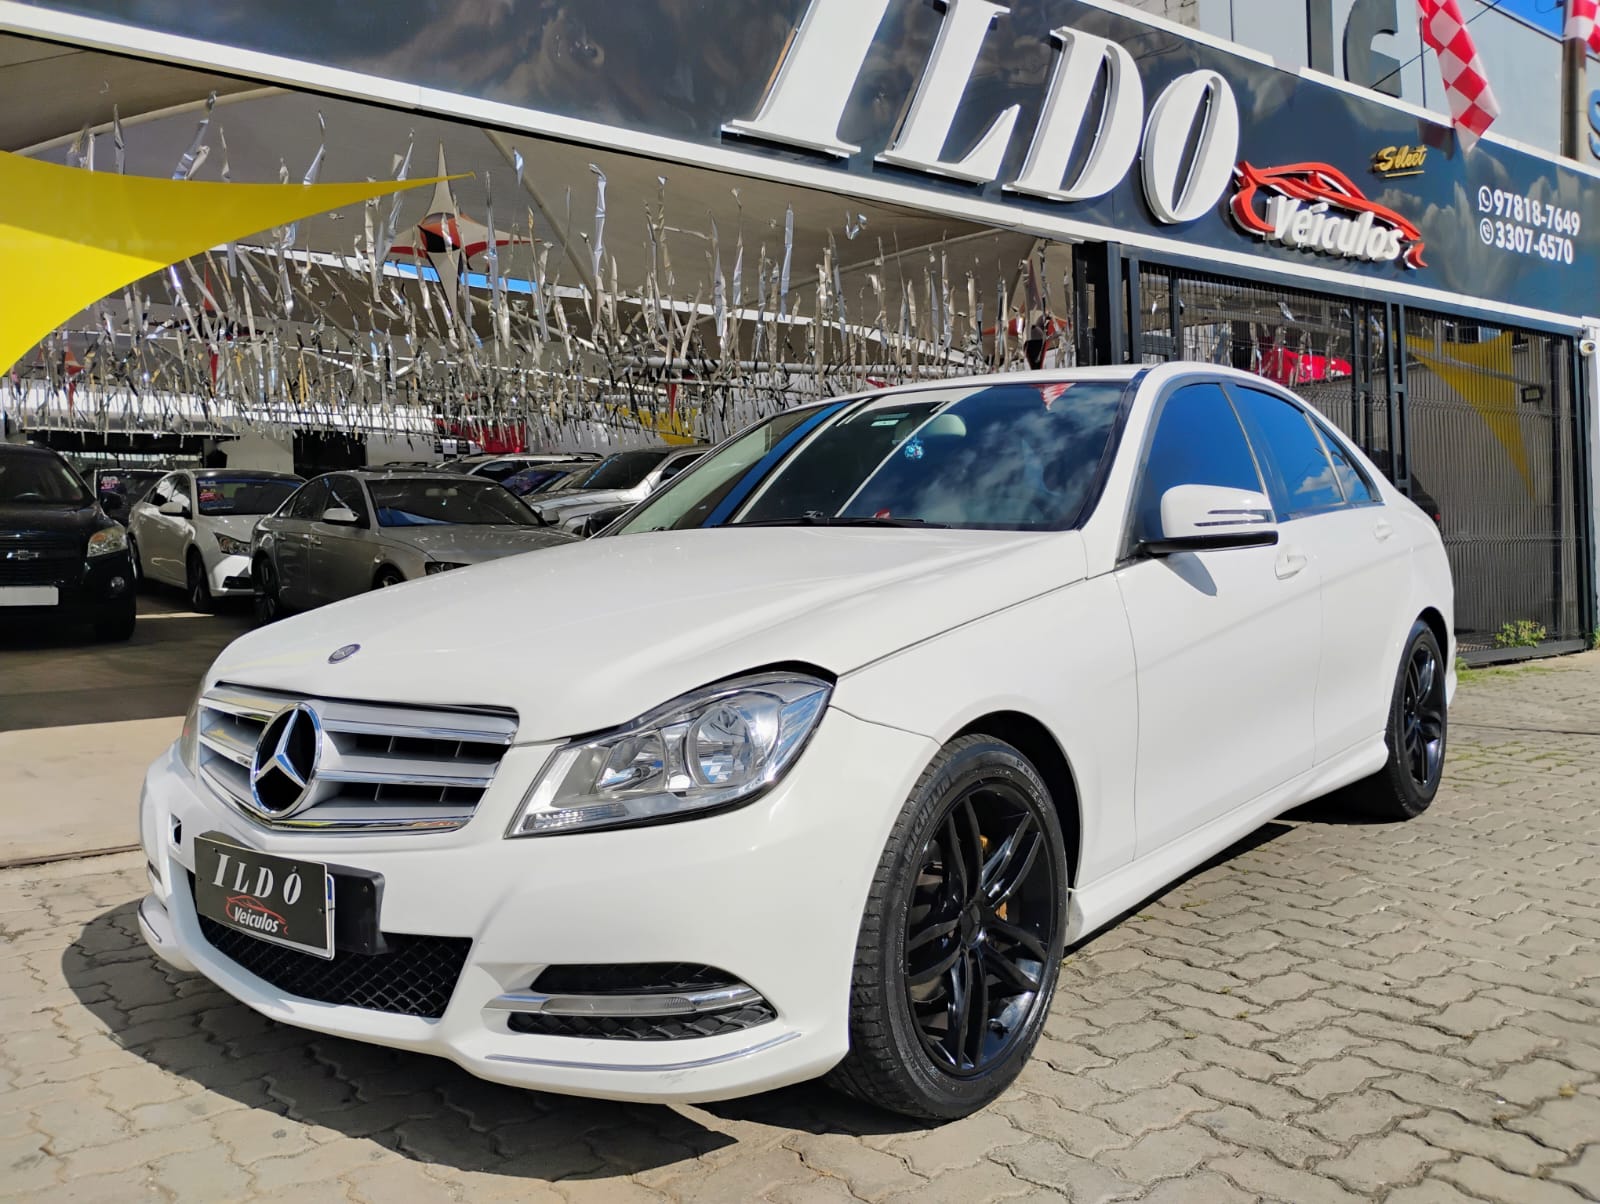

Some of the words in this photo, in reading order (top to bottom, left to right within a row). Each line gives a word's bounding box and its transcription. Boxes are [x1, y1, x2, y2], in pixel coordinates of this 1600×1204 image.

[721, 0, 1239, 224] ILDO
[1374, 144, 1428, 171] Select
[1270, 195, 1404, 260] Veículos
[1494, 189, 1580, 236] 97818-7649
[1496, 221, 1573, 264] 3307-6570
[904, 775, 953, 863] MICHELIN
